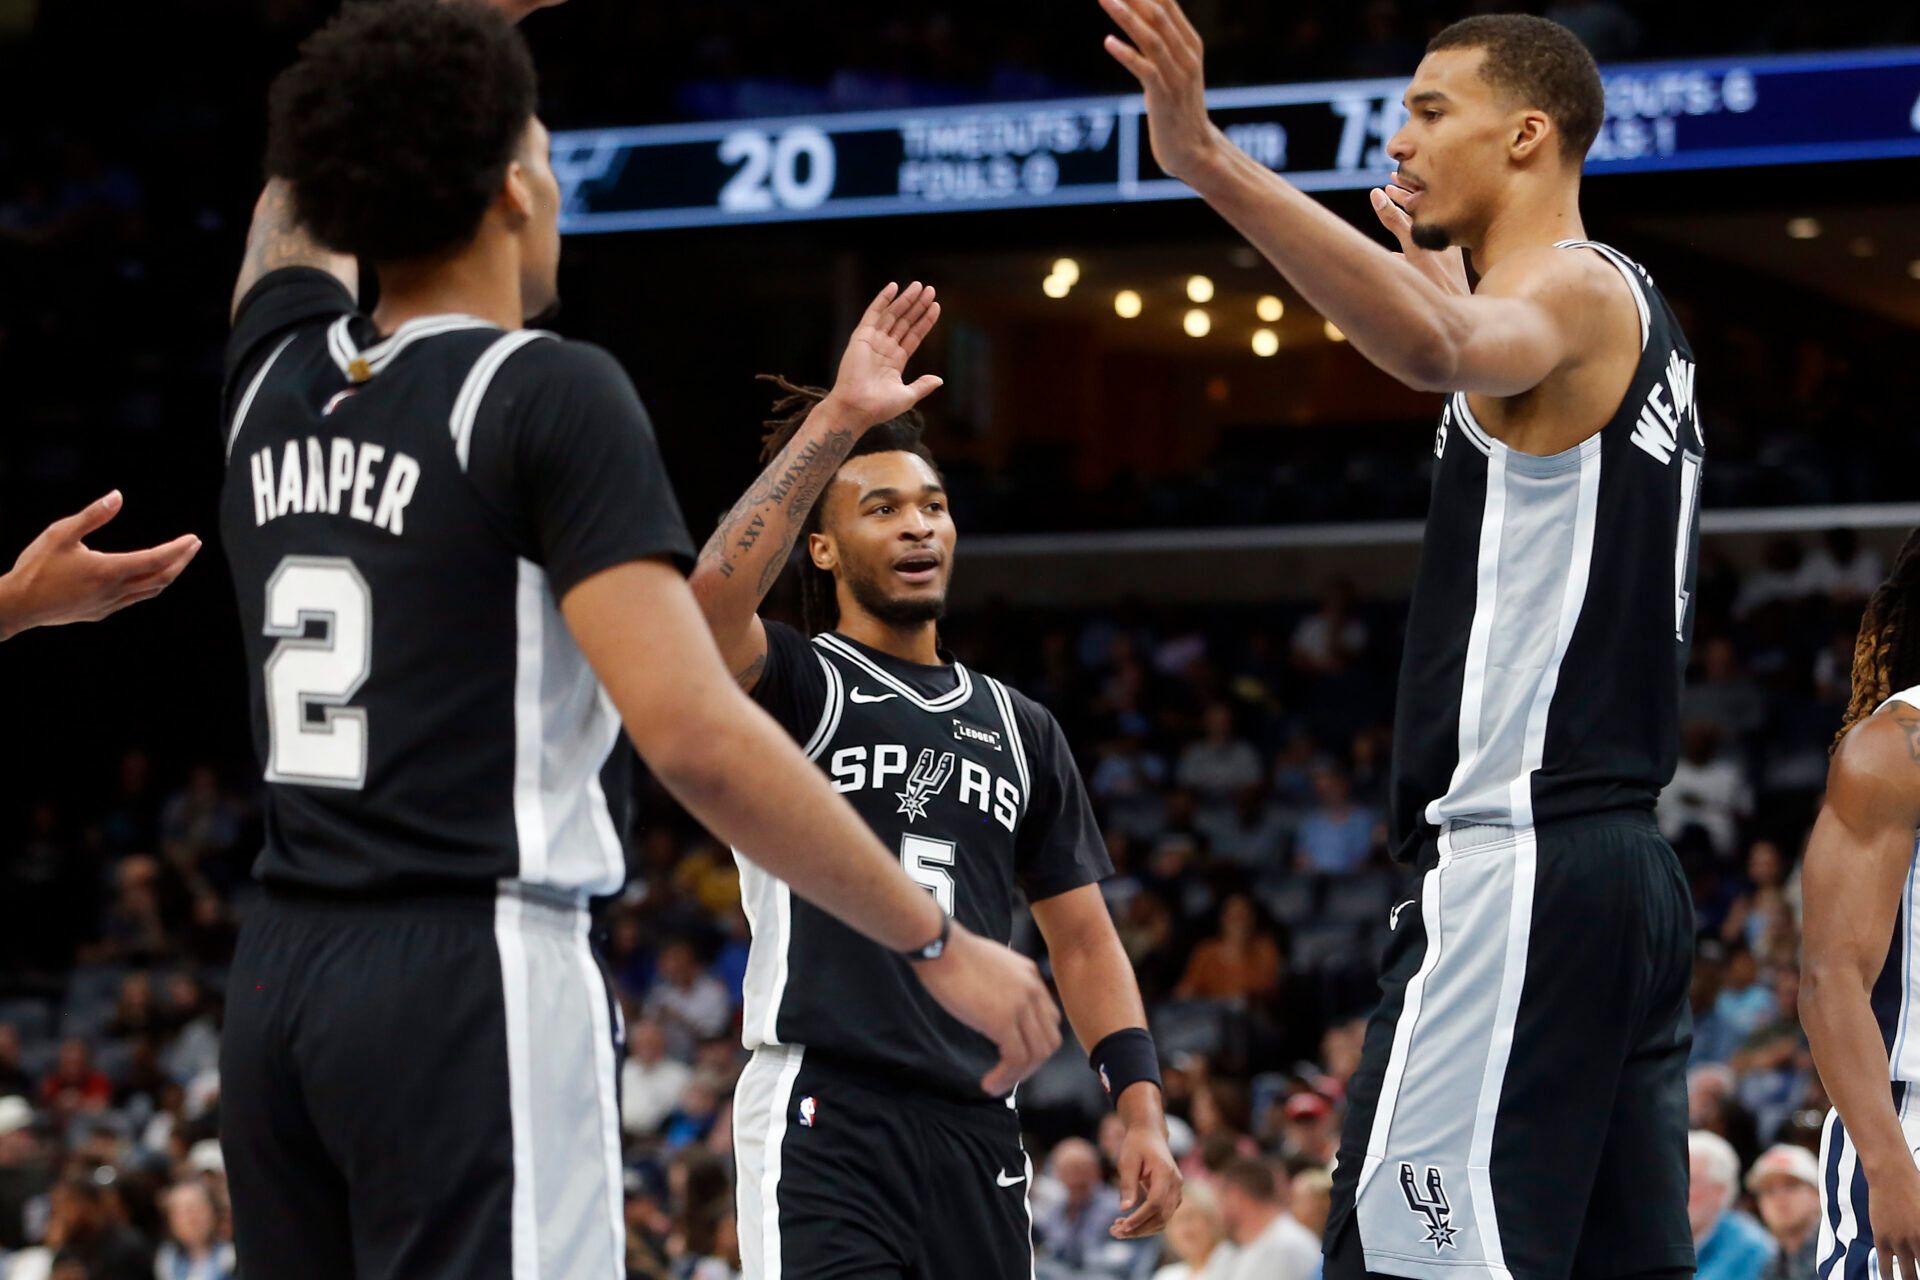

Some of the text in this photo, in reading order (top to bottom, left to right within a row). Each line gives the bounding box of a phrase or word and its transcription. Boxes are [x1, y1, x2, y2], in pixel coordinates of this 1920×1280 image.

[717, 125, 837, 212] 20
[250, 436, 421, 535] HARPER
[264, 554, 373, 791] 2
[959, 726, 996, 745] LEDGER
[900, 832, 957, 918] 5
